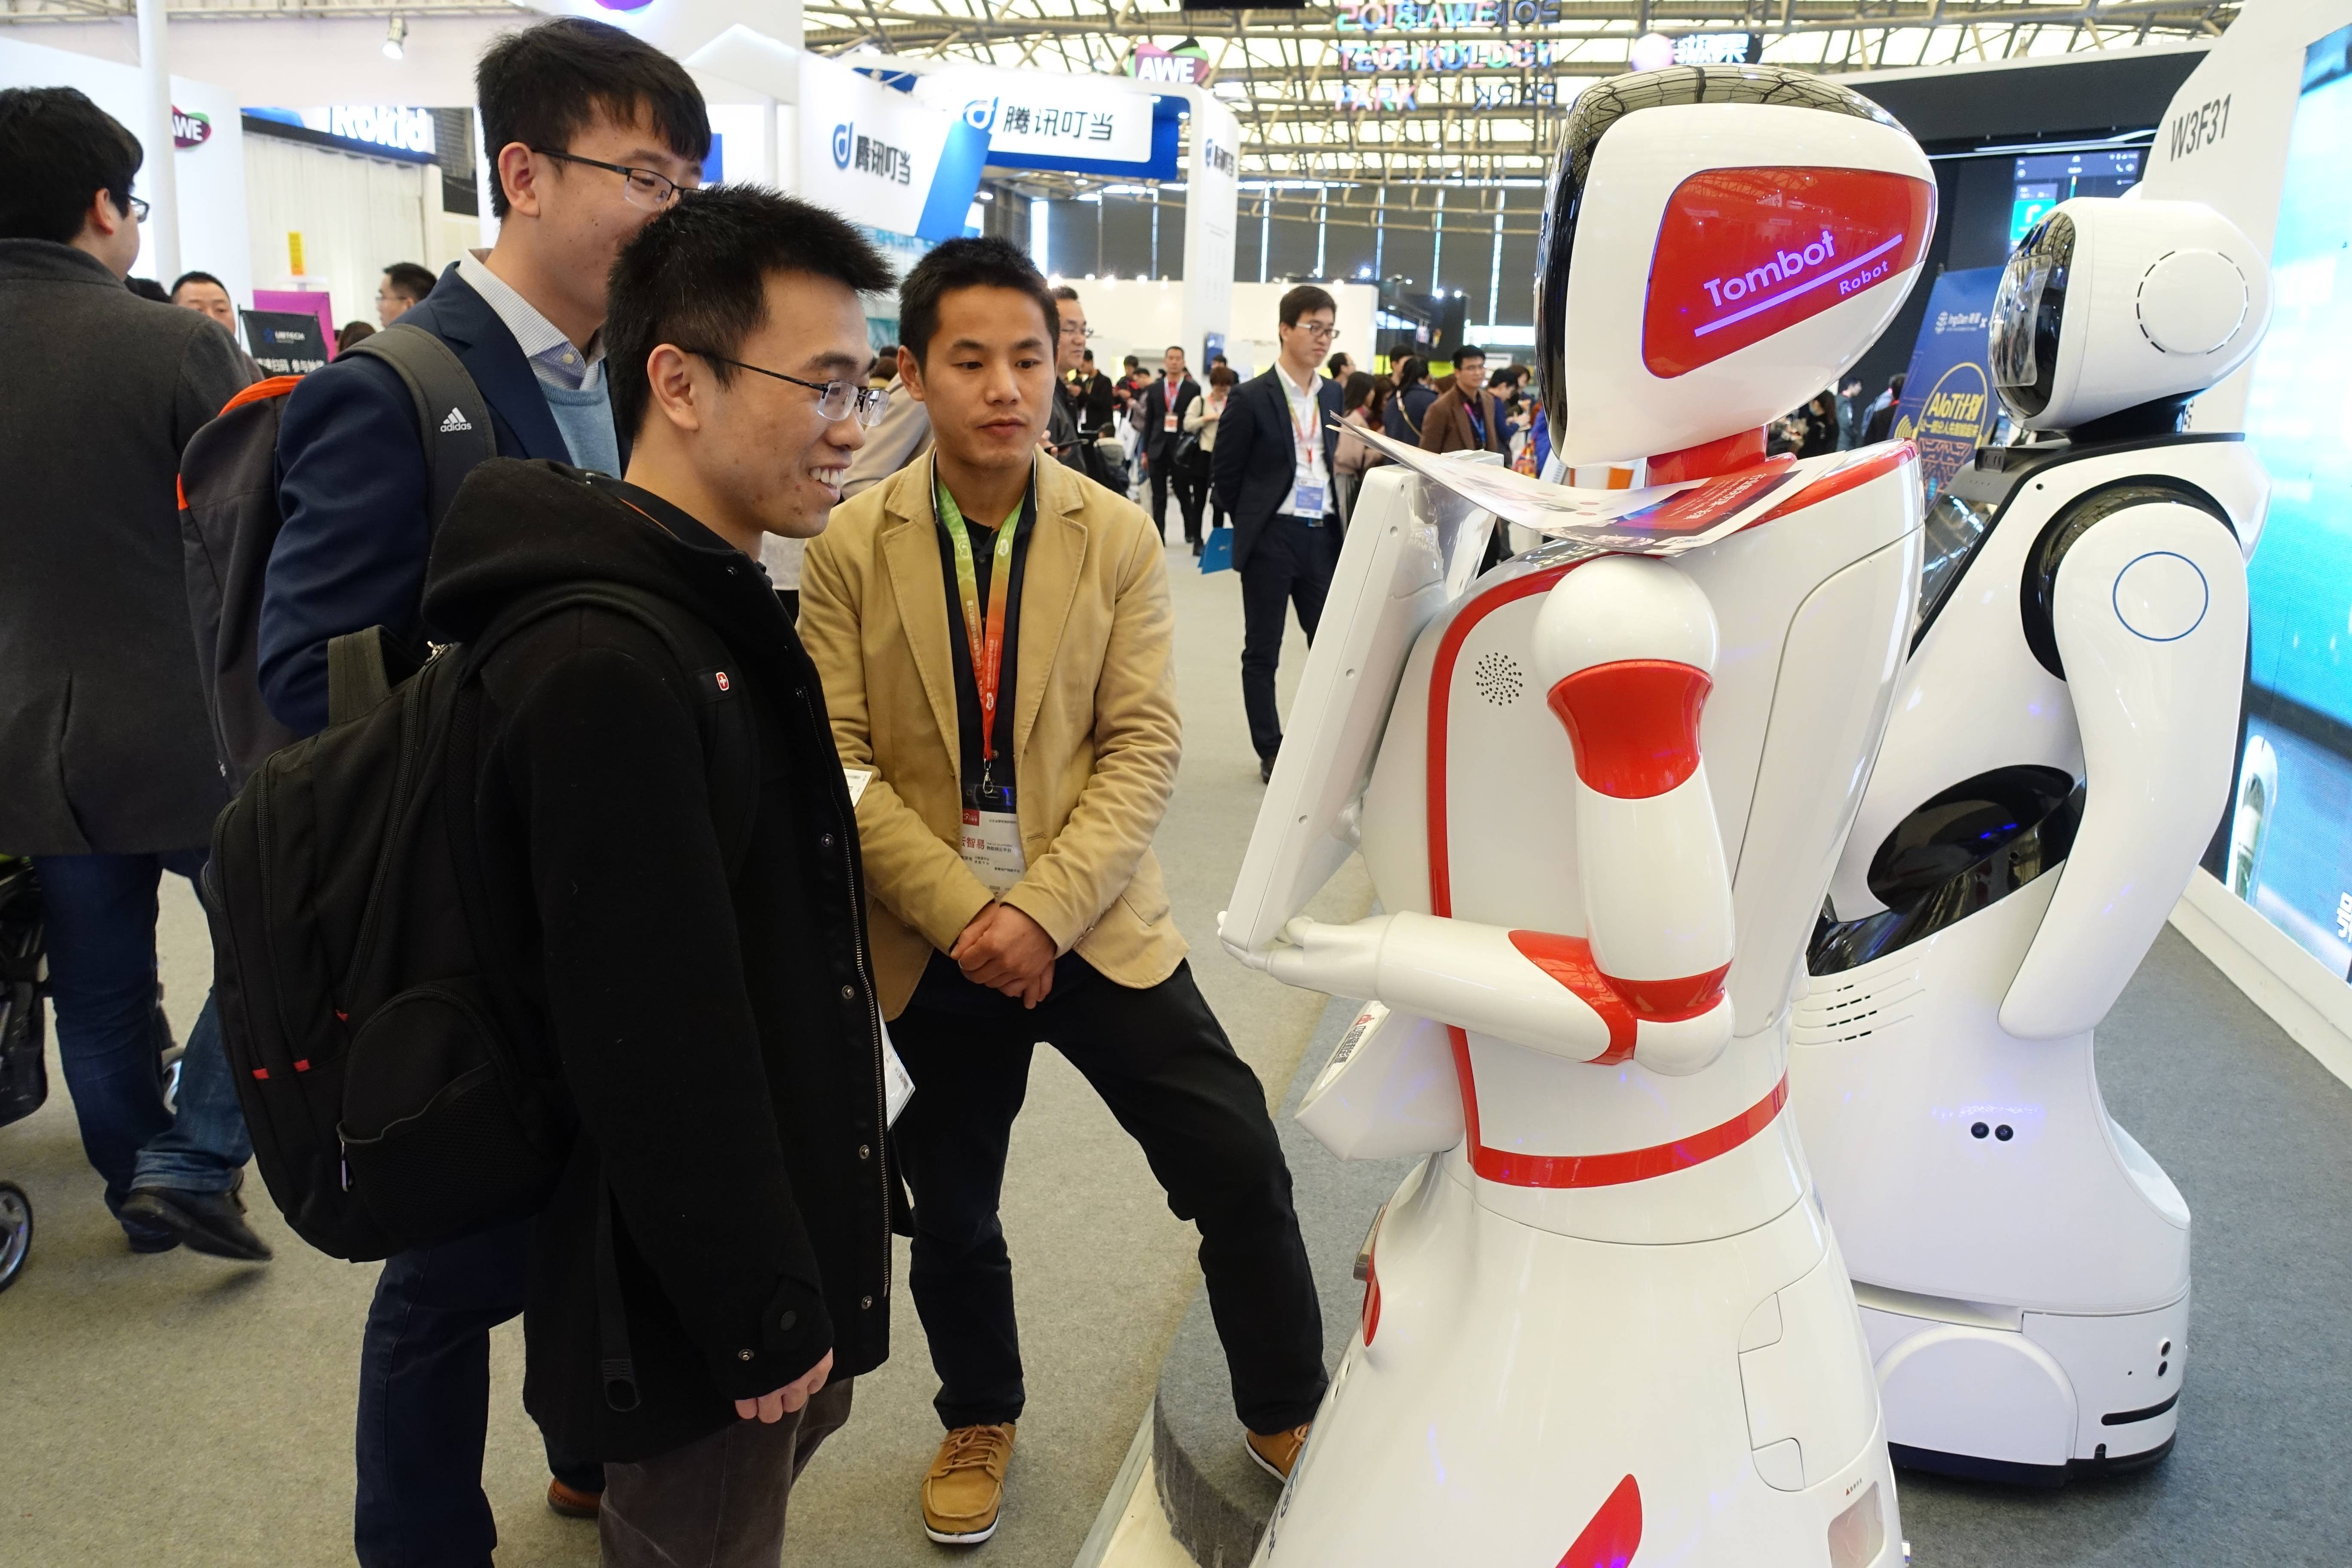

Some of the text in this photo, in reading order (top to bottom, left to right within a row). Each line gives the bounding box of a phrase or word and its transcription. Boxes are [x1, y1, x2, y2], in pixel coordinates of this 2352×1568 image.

[1138, 56, 1195, 83] AWE
[1338, 41, 1558, 71] TECHNOLOGY
[1335, 85, 1417, 111] PARK
[1003, 106, 1113, 141] 腾讯叮当
[2170, 93, 2232, 162] W3F31
[854, 135, 911, 185] 腾讯叮当
[1703, 230, 1834, 307] Tombot
[1839, 260, 1889, 295] Robot
[440, 422, 472, 432] adidas
